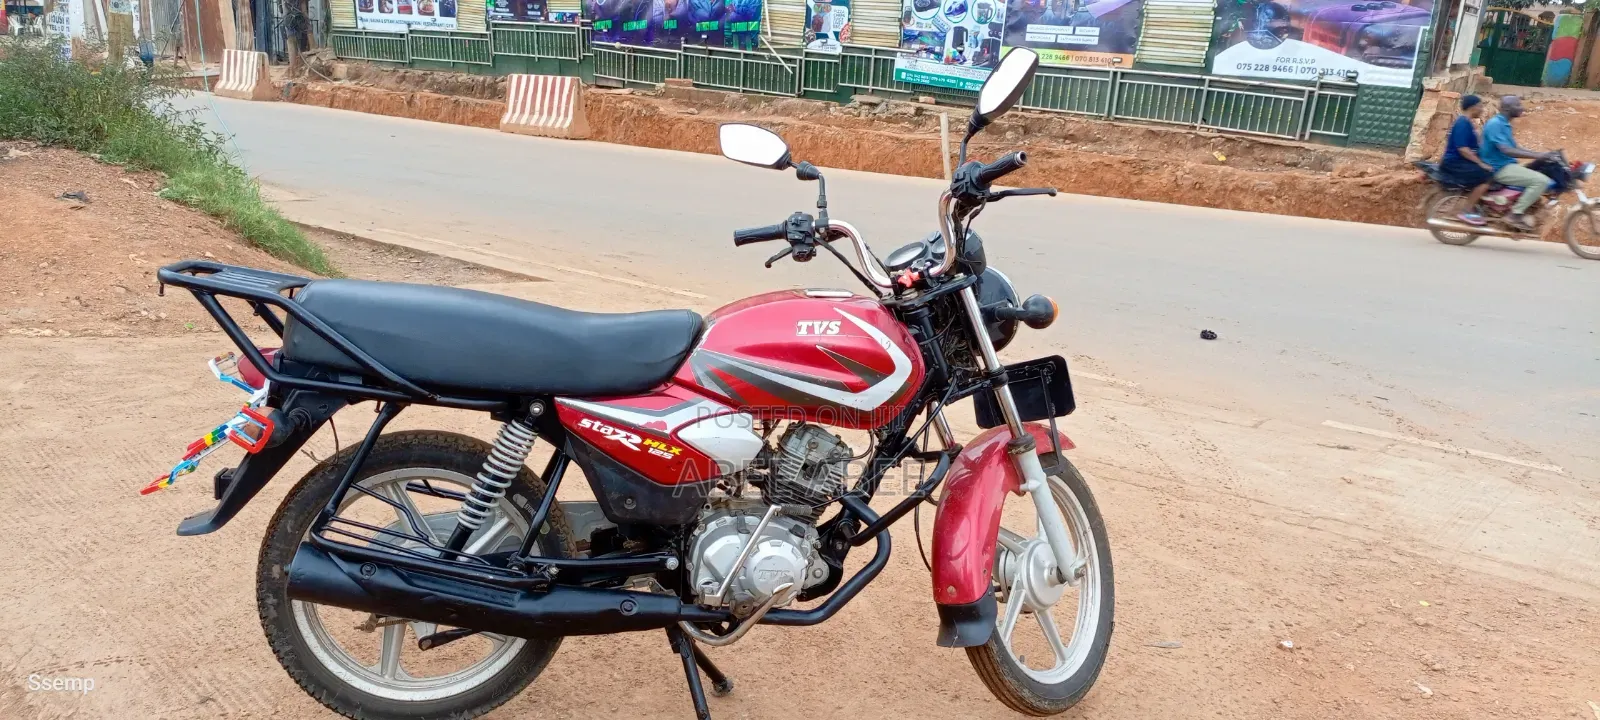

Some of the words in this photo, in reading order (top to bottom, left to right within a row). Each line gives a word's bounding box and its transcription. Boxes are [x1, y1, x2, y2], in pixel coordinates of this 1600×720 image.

[1275, 56, 1291, 64] FOR
[1236, 63, 1252, 71] 075
[1254, 64, 1270, 72] 228
[1272, 65, 1294, 74] 9466
[1300, 67, 1318, 75] 070
[797, 321, 842, 335] TVS
[642, 438, 682, 455] HLX
[647, 447, 675, 460] 125
[758, 569, 791, 581] TVS
